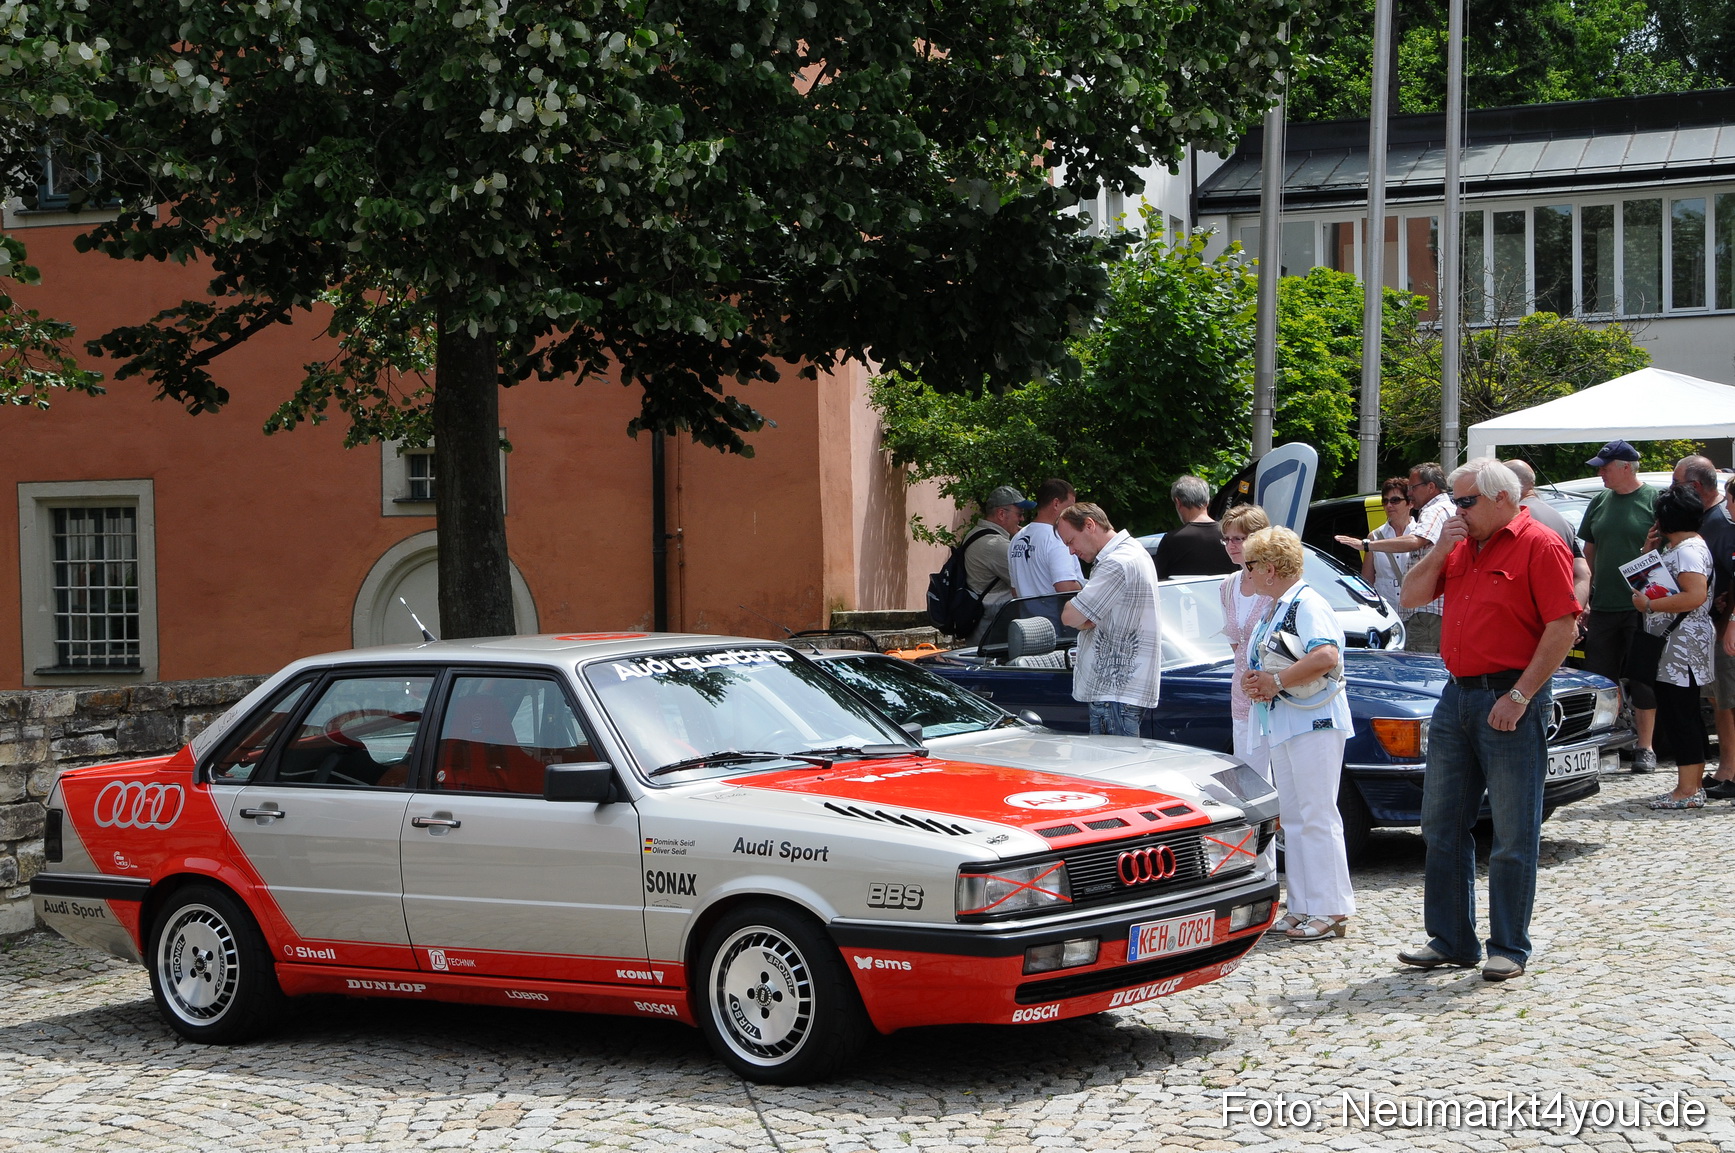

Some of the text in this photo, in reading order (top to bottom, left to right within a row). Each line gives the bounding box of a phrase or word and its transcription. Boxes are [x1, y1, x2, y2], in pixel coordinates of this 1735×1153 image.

[612, 649, 794, 682] Audi quattro
[1564, 755, 1572, 773] S
[1574, 751, 1591, 771] 107
[652, 847, 670, 855] Oliver
[653, 838, 696, 847] Dominik Seidl
[732, 837, 829, 862] Audi Sport
[646, 870, 697, 896] SONAX
[867, 883, 925, 910] BBS
[44, 900, 105, 919] Audi Sport
[1139, 924, 1169, 955] KEH
[1178, 916, 1212, 947] 0781
[296, 946, 336, 959] Shell
[447, 957, 476, 967] TECHNIK
[875, 959, 912, 970] sms
[616, 970, 653, 980] KONI
[346, 979, 427, 993] DUNLOP
[505, 990, 549, 1001] LÖBRO
[1109, 977, 1184, 1007] DUNLOP
[633, 1001, 678, 1016] BOSCH
[1012, 1003, 1060, 1023] BOSCH
[731, 1001, 757, 1037] TURBO
